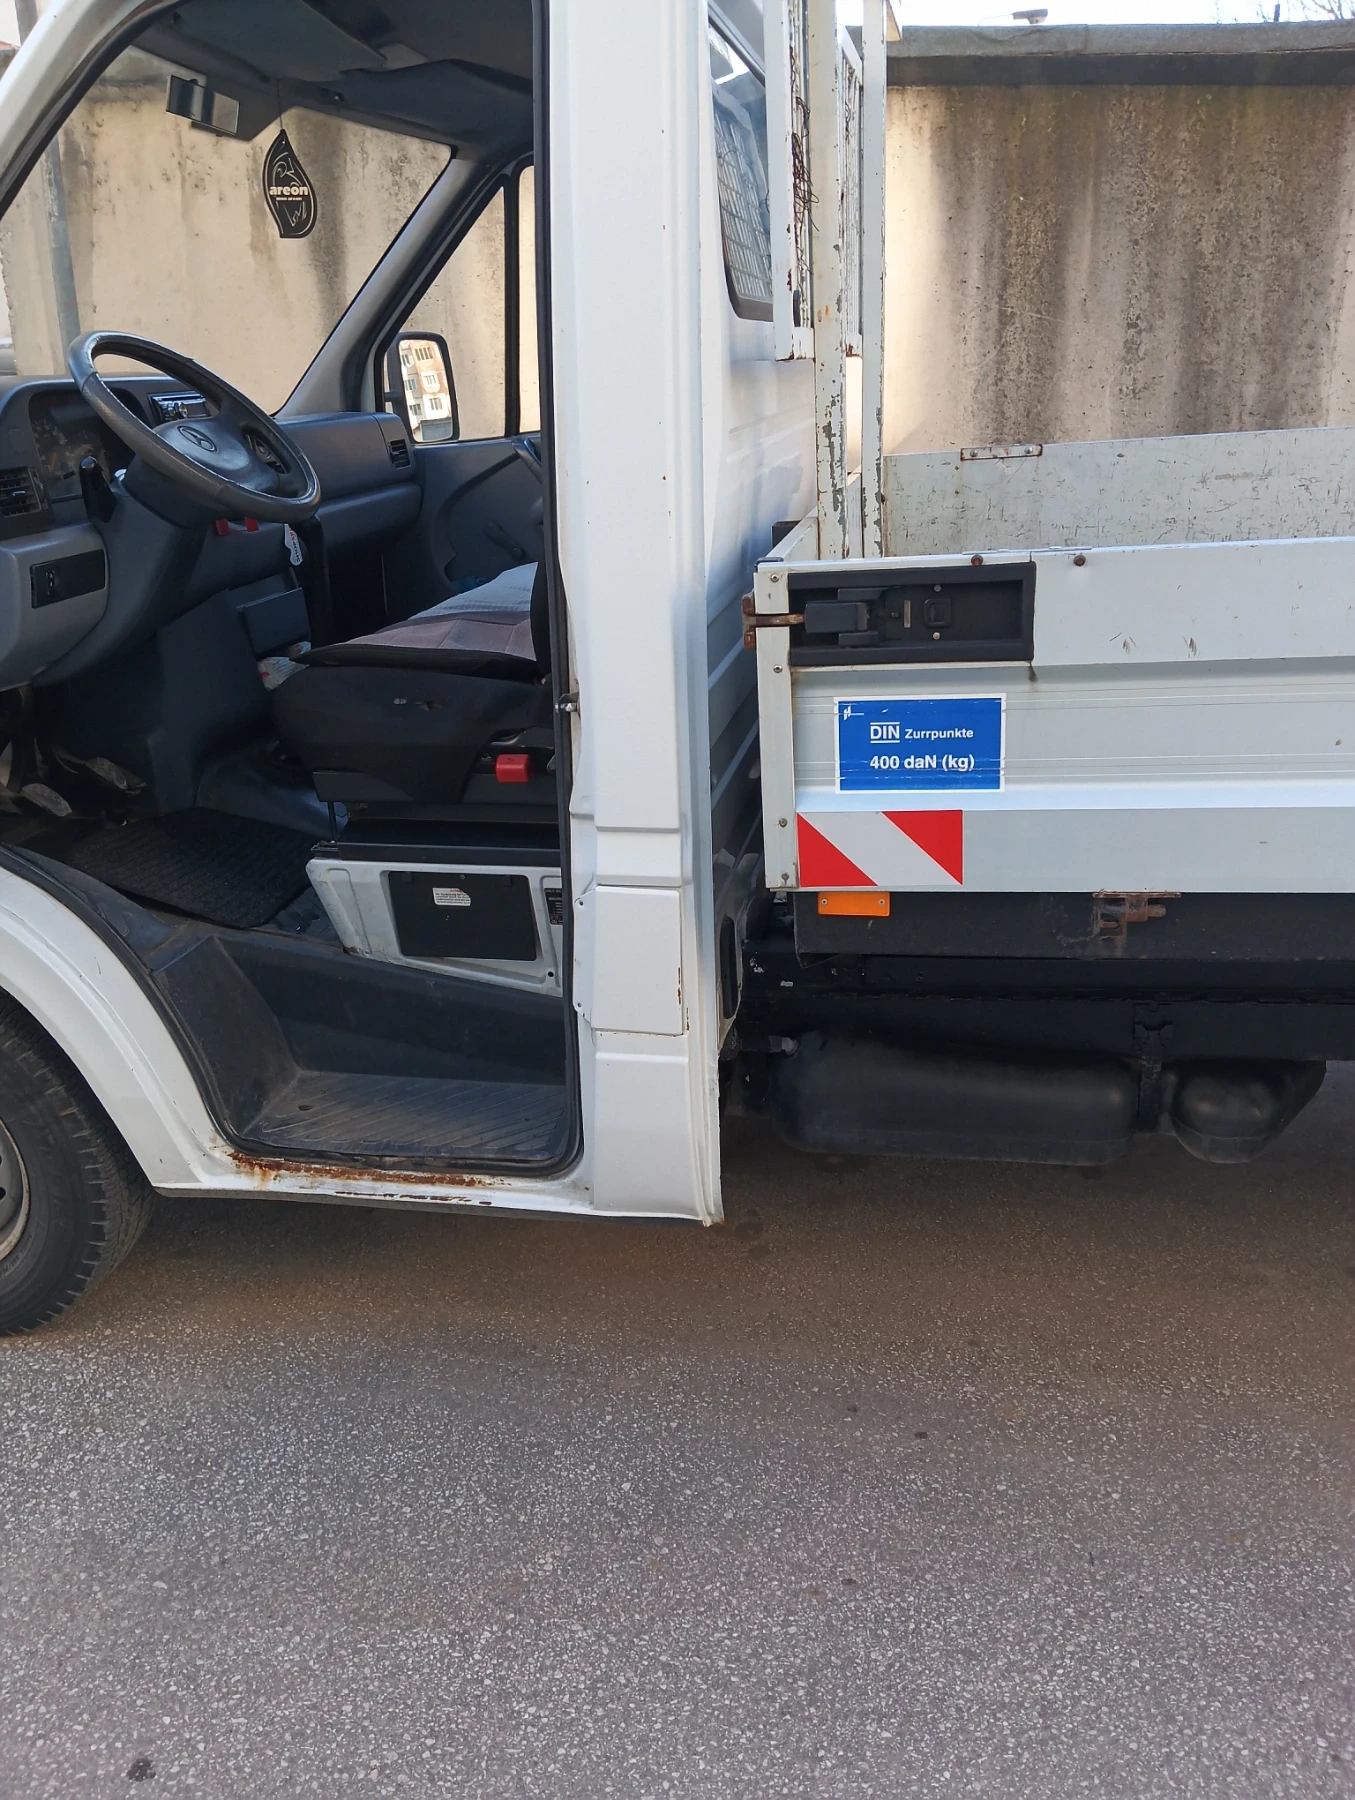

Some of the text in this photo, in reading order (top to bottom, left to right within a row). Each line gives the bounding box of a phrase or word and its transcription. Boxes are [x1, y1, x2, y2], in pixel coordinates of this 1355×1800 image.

[269, 186, 308, 195] areon
[870, 725, 974, 740] DIN Zurrpunkte
[870, 754, 975, 771] 400 daN (kg)
